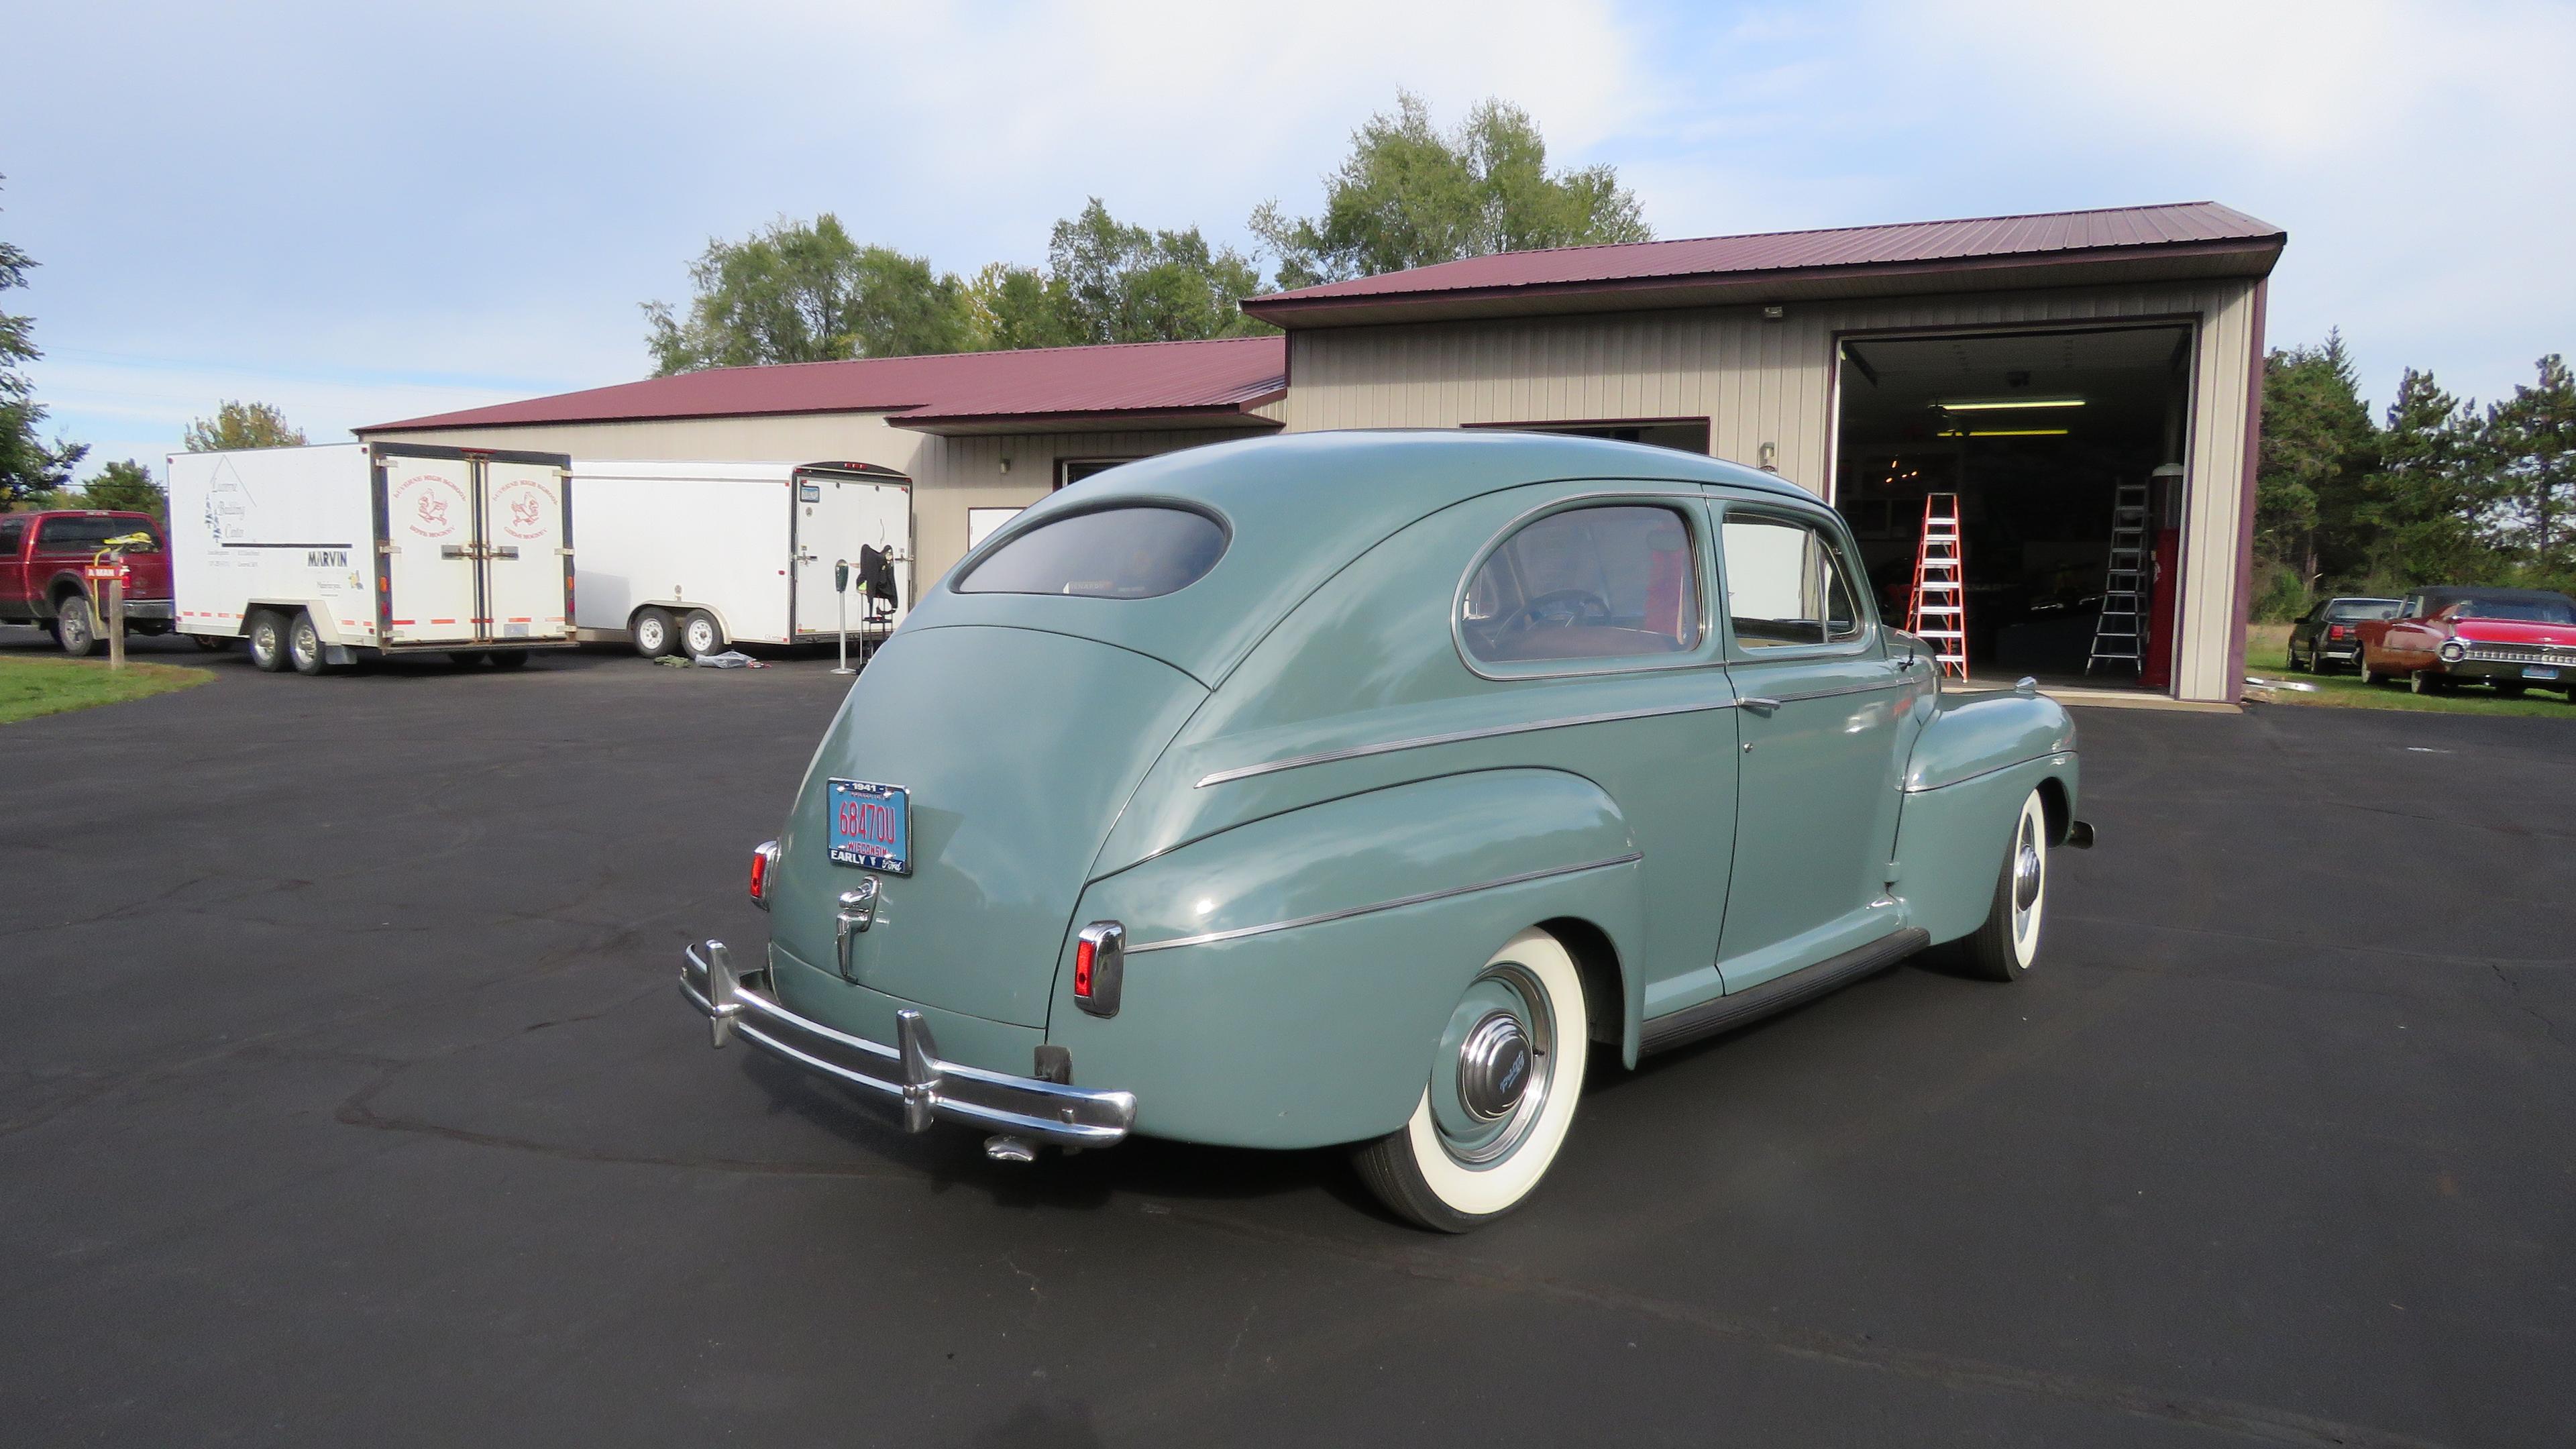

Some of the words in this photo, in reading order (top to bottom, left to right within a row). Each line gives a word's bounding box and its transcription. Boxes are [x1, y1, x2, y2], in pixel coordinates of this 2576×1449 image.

[443, 478, 466, 502] SCHOOL
[520, 480, 537, 488] HIGH
[537, 483, 558, 506] SCHOOL
[308, 551, 347, 567] MARVIN
[852, 783, 876, 792] 1941
[848, 841, 889, 859] WISCONSIN
[831, 850, 865, 864] EARLY
[881, 859, 902, 871] Ford
